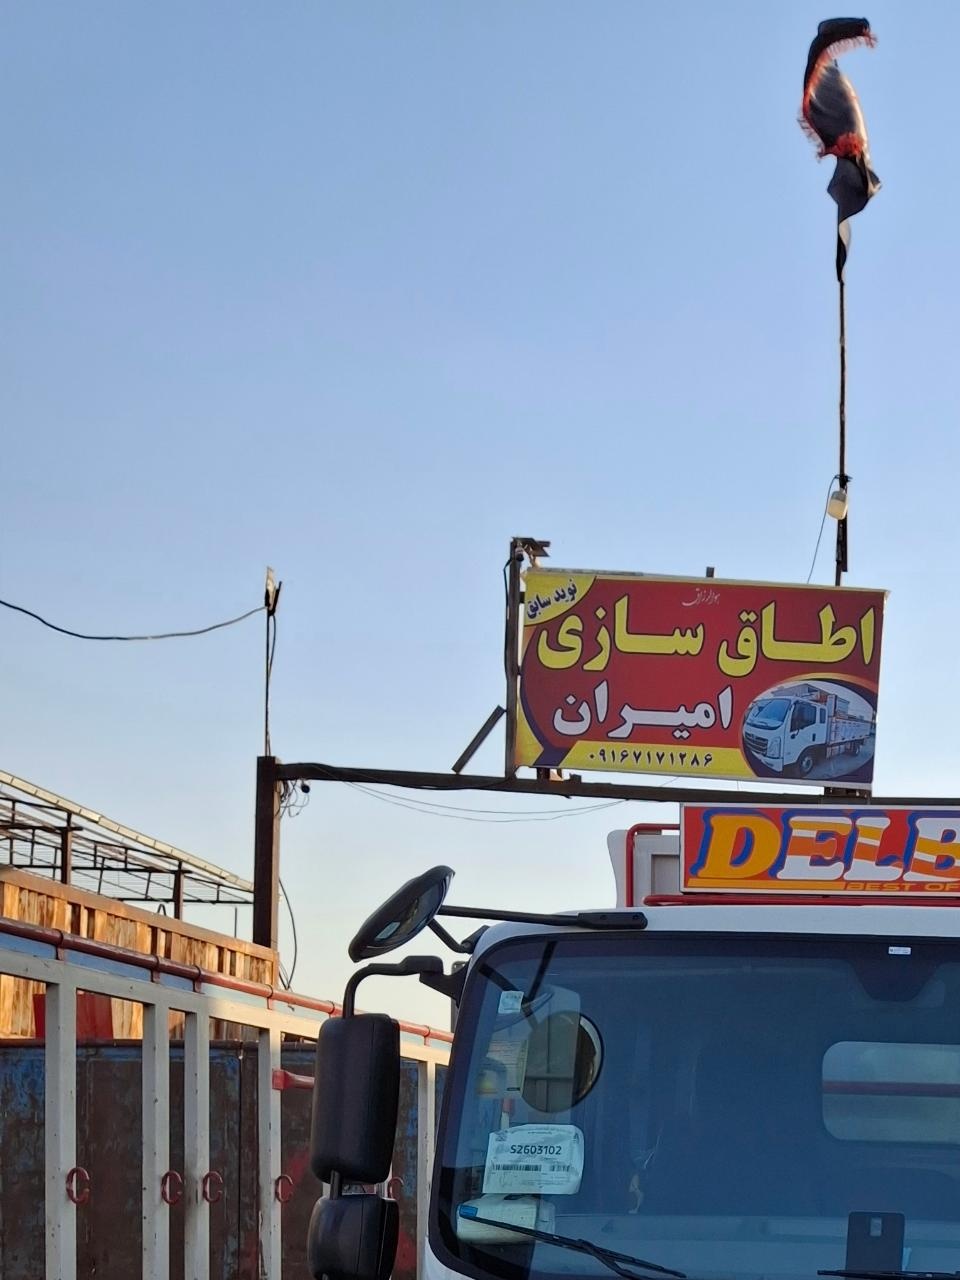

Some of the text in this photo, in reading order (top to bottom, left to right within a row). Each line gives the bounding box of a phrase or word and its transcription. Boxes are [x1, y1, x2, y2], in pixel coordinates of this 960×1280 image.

[537, 594, 875, 678] اطاق سازی
[553, 680, 734, 740] امیران
[845, 881, 916, 892] BEST
[510, 1144, 562, 1155] S2603102
